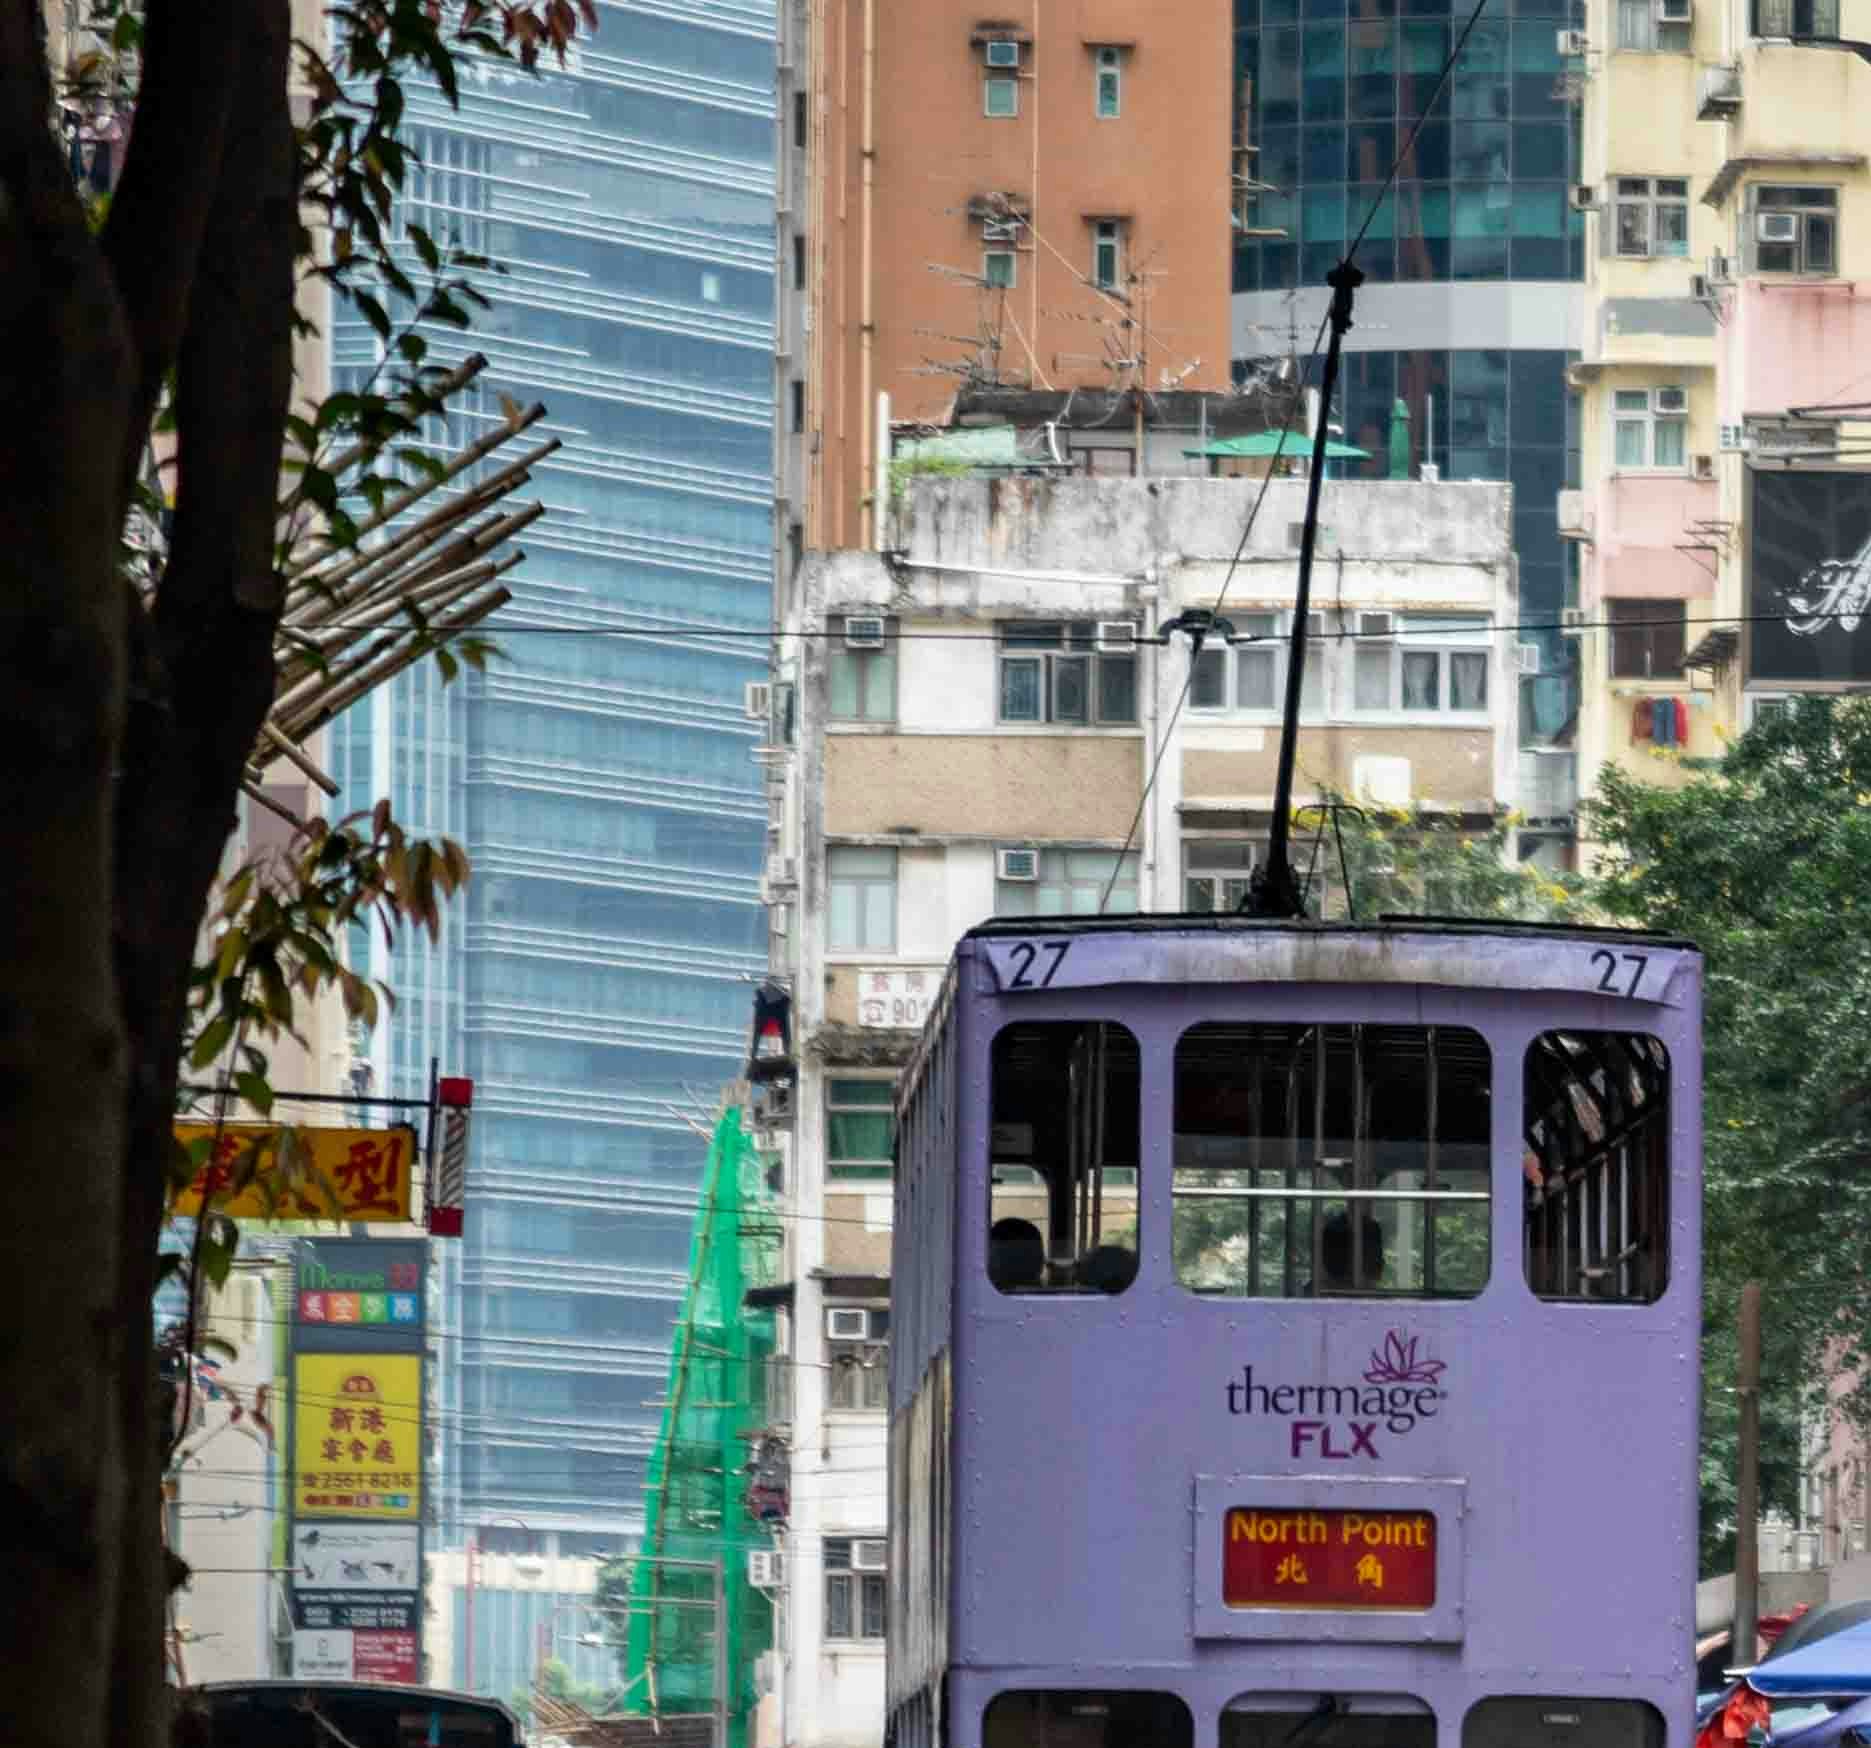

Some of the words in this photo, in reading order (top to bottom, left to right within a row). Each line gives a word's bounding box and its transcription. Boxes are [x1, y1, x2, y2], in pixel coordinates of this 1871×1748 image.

[1010, 942, 1072, 989] 27
[1591, 949, 1649, 1000] 27
[1226, 1364, 1438, 1434] thermage
[1289, 1422, 1380, 1460] FLX
[1231, 1511, 1328, 1544] North
[1341, 1512, 1428, 1548] Point
